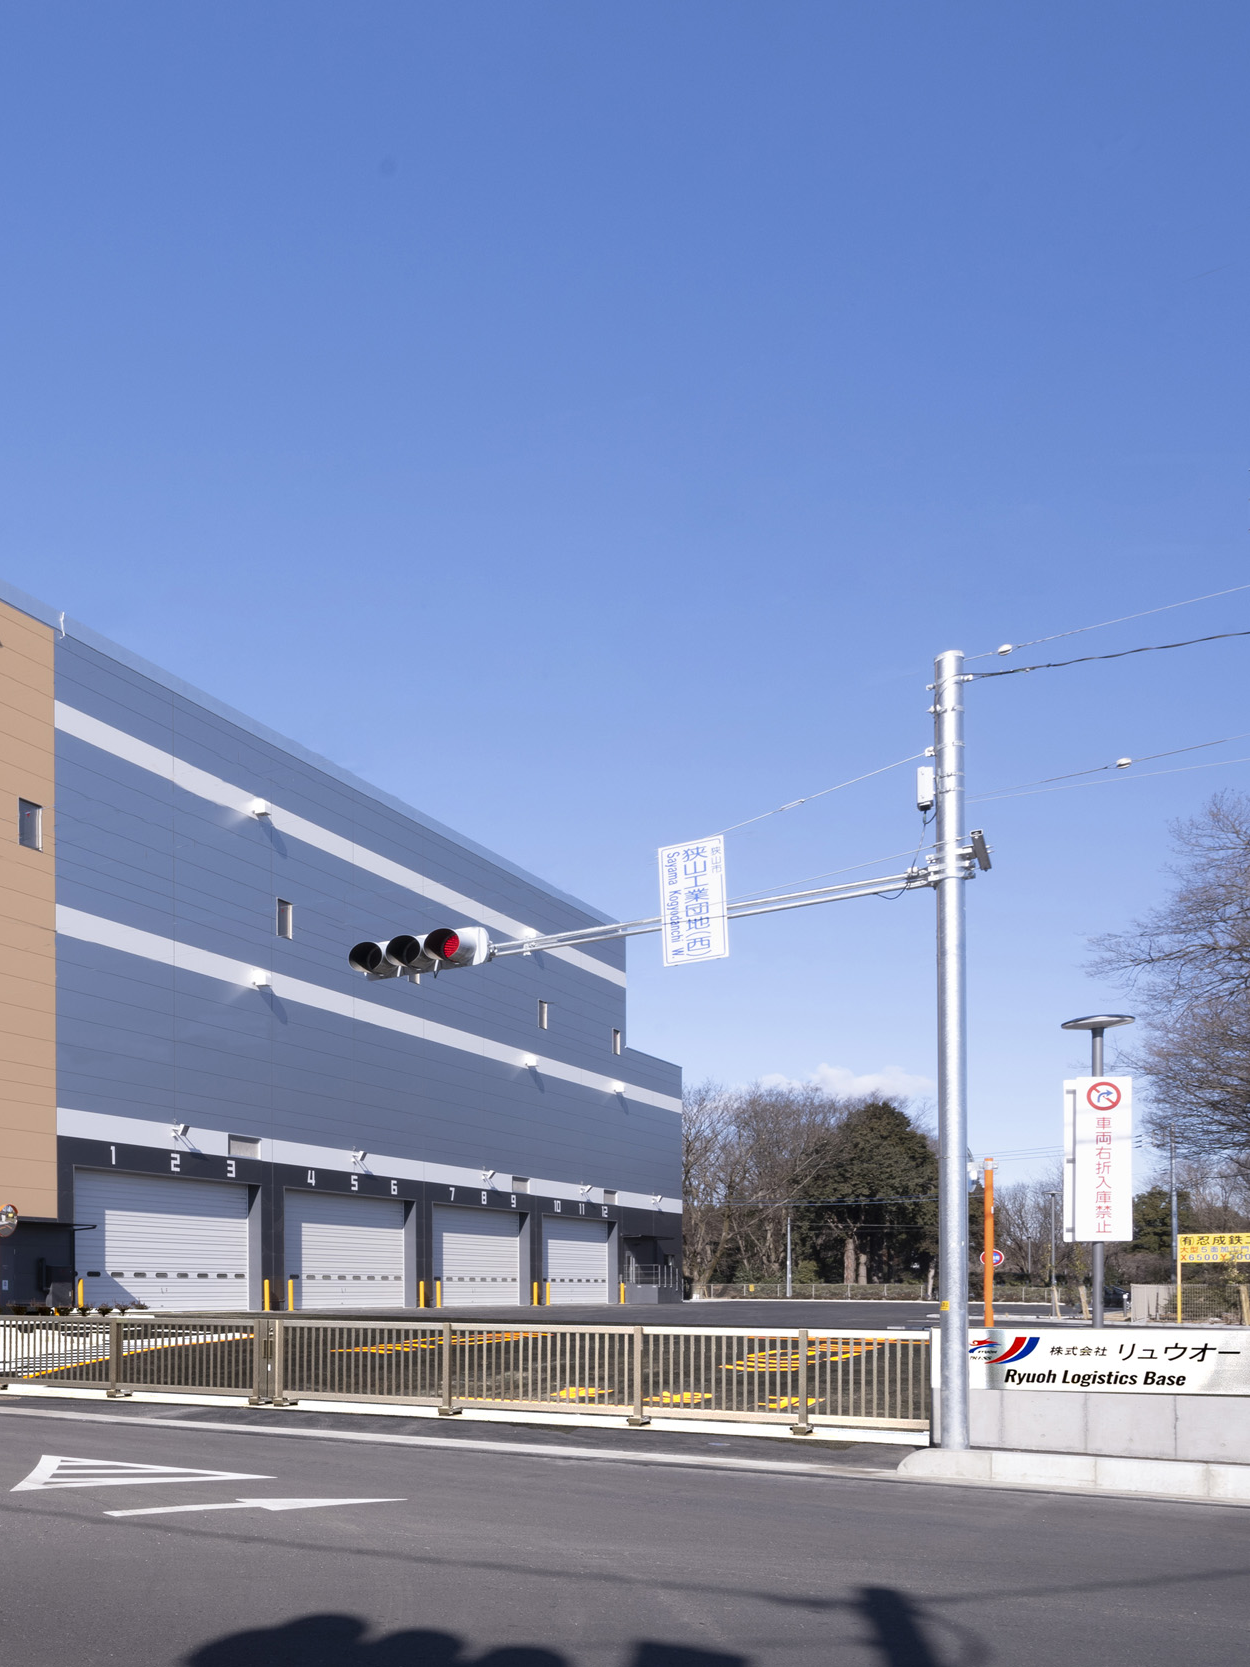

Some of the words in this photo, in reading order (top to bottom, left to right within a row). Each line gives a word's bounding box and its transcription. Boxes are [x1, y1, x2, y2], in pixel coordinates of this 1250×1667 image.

[664, 851, 681, 886] Sayama
[710, 846, 722, 874] 狭山市
[666, 889, 684, 943] Kogyodanchi
[671, 947, 685, 959] W.
[110, 1145, 116, 1165] 1
[170, 1153, 180, 1172] 2
[226, 1159, 236, 1178] 3
[1095, 1116, 1112, 1234] 車両右折入庫禁止
[307, 1169, 316, 1186] 4
[350, 1175, 358, 1191] 5
[391, 1180, 398, 1195] 6
[449, 1187, 455, 1201] 7
[481, 1191, 487, 1205] 8
[511, 1195, 517, 1208] 9
[554, 1200, 561, 1213] 10
[579, 1203, 585, 1215] 11
[601, 1206, 608, 1218] 12
[1049, 1345, 1108, 1357] 株式会社
[1118, 1342, 1241, 1363] リュウオー
[1004, 1369, 1057, 1385] Ryuoh
[1062, 1370, 1138, 1387] Logistics
[1143, 1371, 1186, 1386] Base
